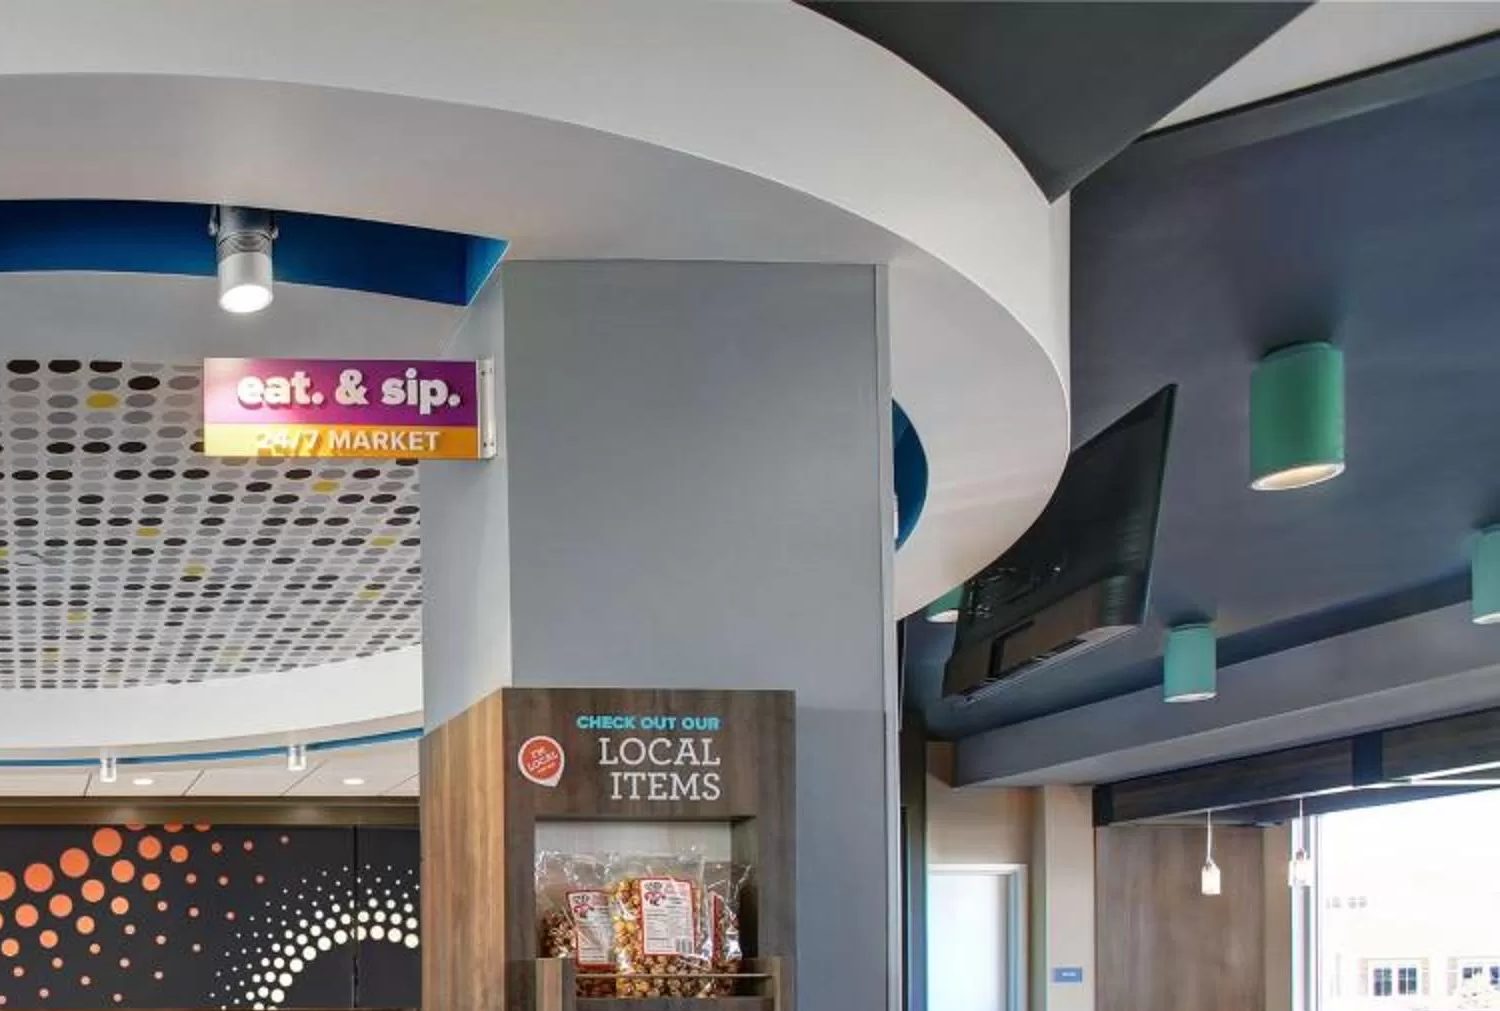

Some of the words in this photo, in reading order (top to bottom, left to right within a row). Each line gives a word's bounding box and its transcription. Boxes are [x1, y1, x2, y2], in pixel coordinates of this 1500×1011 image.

[237, 371, 324, 407] eat.
[335, 369, 369, 406] &
[380, 367, 460, 415] sip.
[259, 429, 320, 450] 24/7
[329, 430, 440, 451] MARKET
[576, 716, 636, 730] CHECK
[640, 716, 677, 731] OUT
[682, 717, 721, 731] OUR
[599, 737, 721, 766] LOCAL
[610, 772, 721, 800] ITEMS
